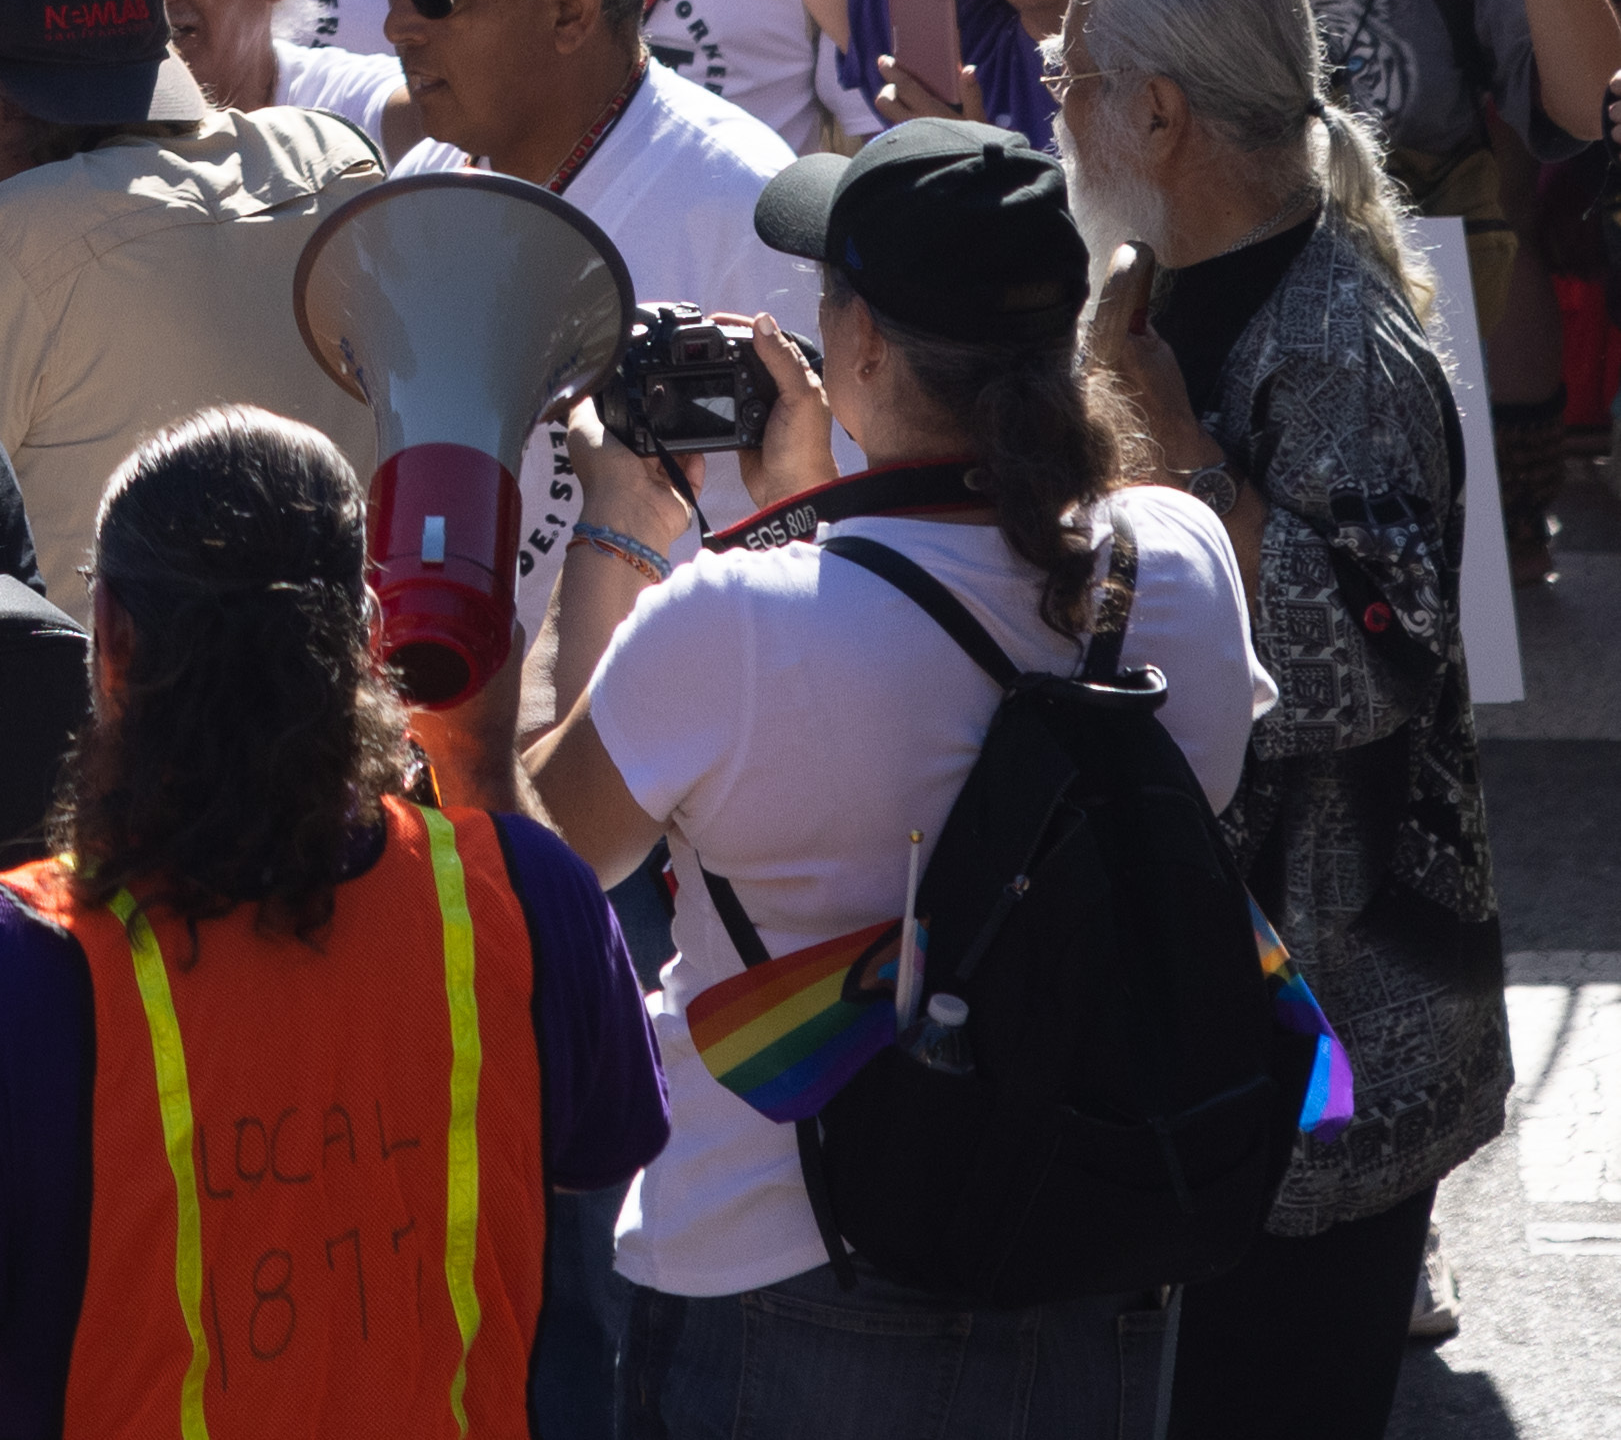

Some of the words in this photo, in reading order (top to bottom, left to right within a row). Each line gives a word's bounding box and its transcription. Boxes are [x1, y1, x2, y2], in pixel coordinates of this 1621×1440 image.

[744, 519, 787, 553] EOS
[785, 504, 818, 536] 80D
[198, 1098, 422, 1200] LOCAL
[208, 1215, 424, 1393] 1877
